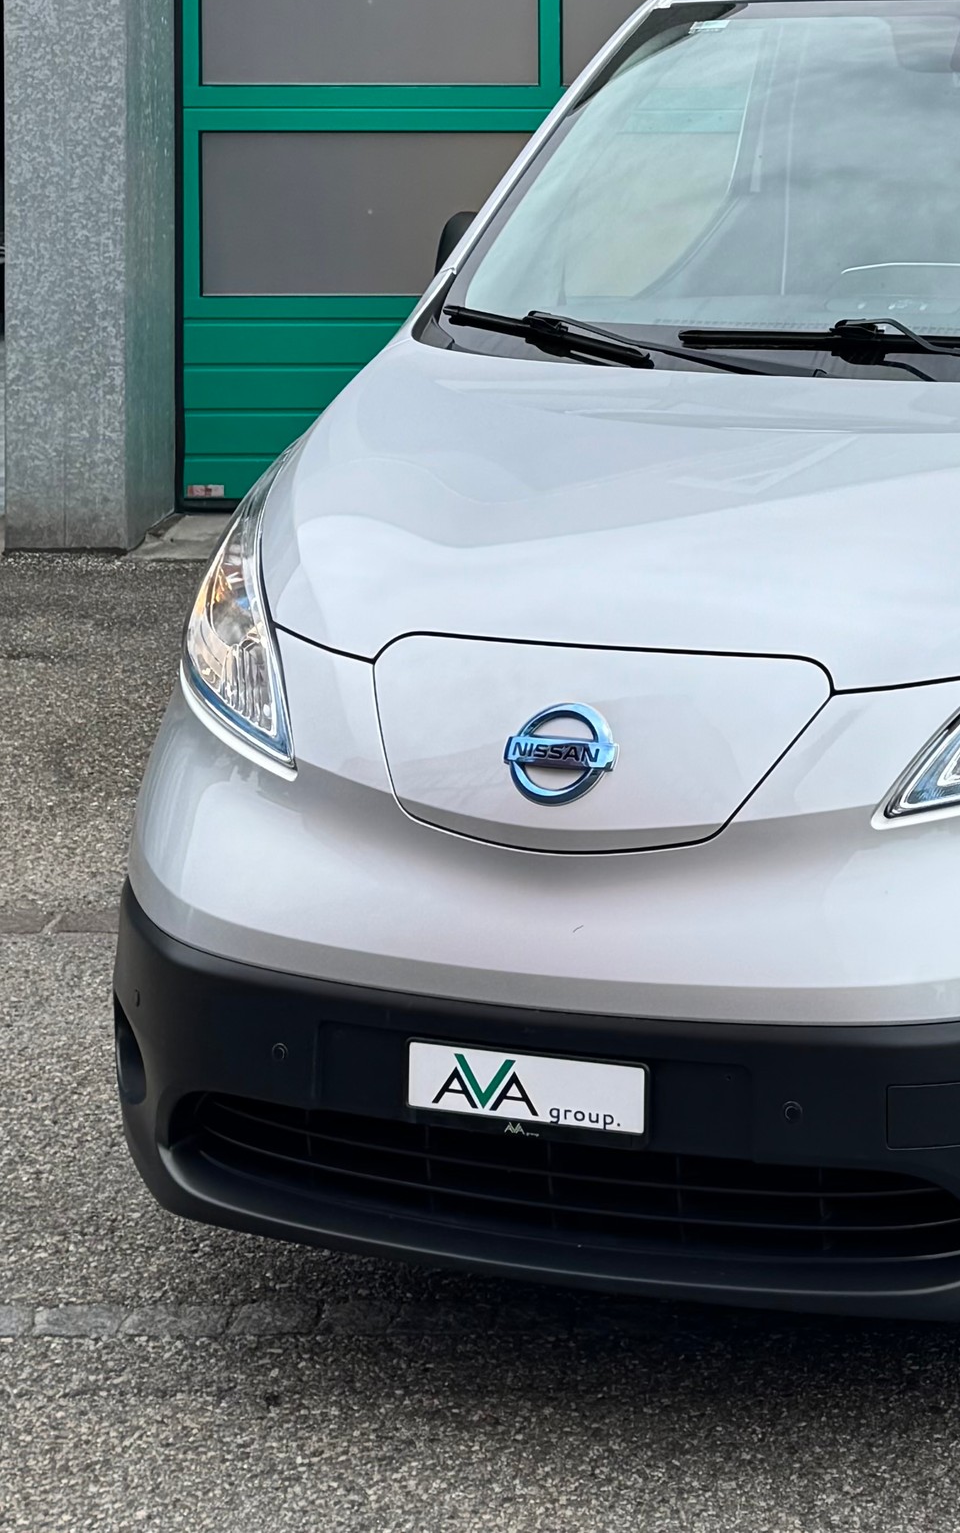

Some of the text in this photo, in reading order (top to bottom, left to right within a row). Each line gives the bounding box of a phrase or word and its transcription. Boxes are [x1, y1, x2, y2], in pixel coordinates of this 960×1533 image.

[512, 741, 600, 763] NISSAN
[431, 1053, 621, 1130] AVA group.
